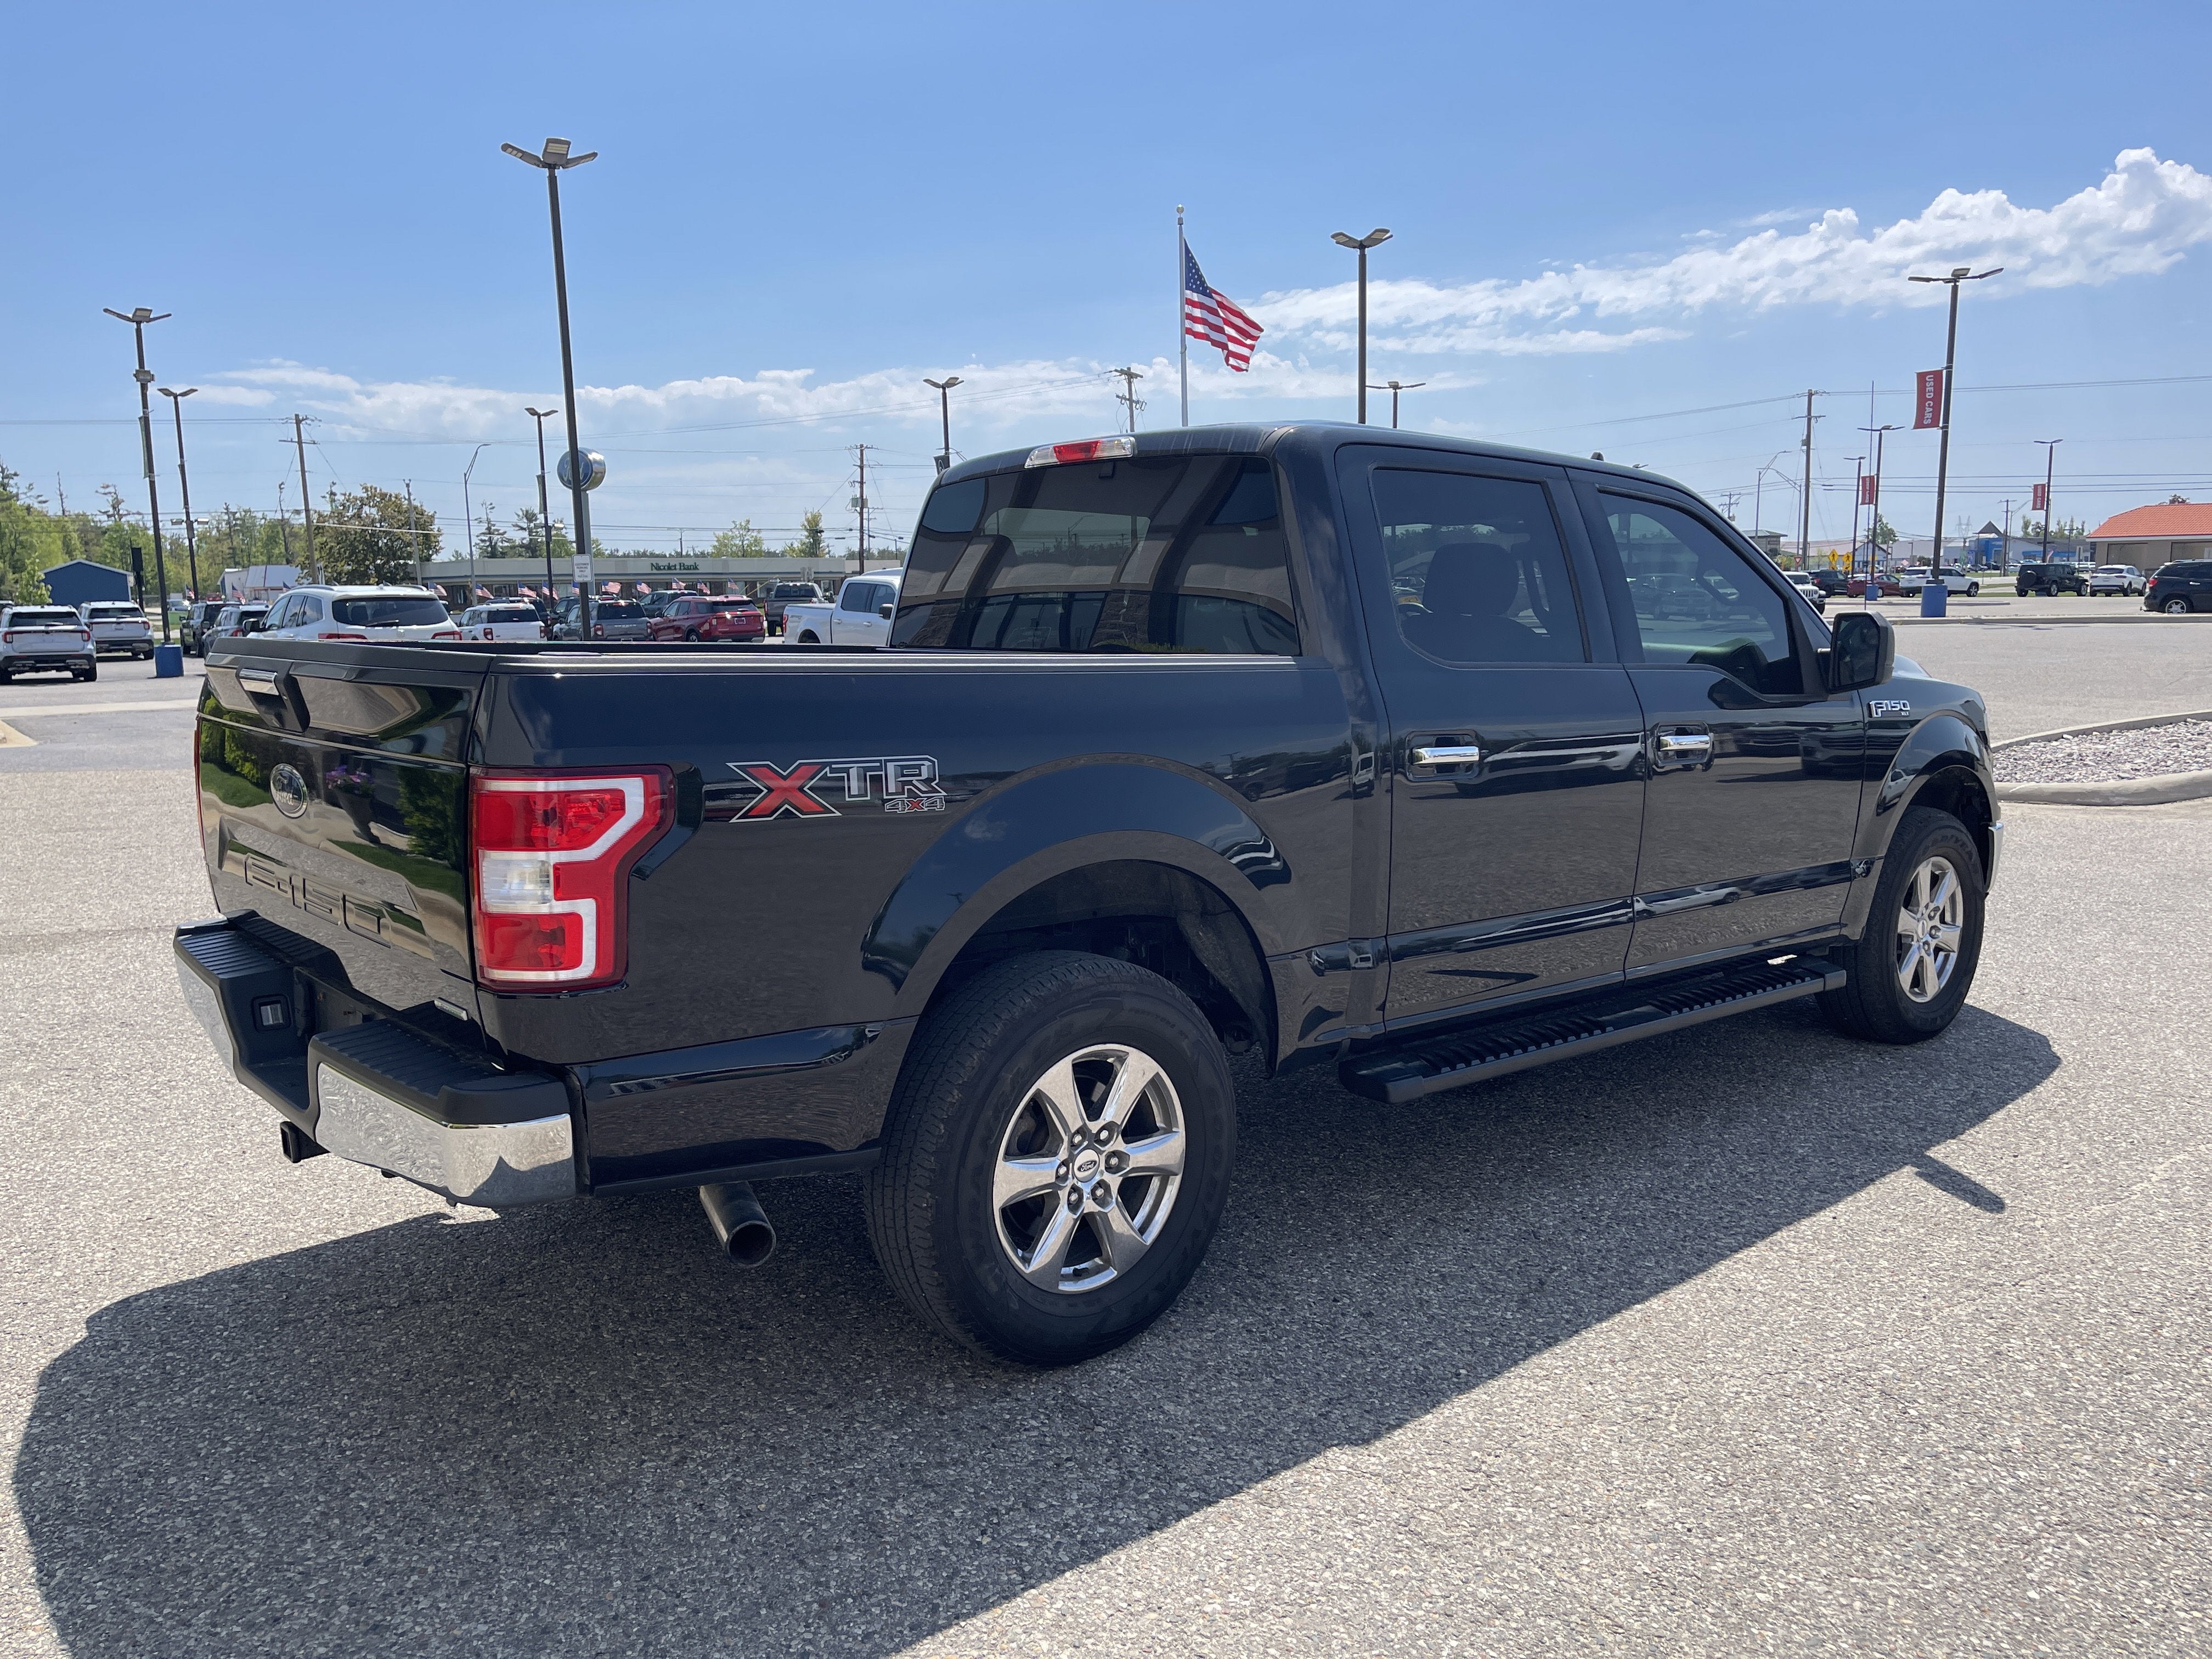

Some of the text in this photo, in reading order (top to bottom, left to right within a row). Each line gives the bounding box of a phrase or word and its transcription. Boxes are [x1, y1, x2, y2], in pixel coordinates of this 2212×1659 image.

[1923, 375, 1934, 425] USED CARS
[651, 562, 699, 571] Nicolet Bank
[726, 755, 947, 822] XTR
[1080, 1161, 1094, 1172] Ford
